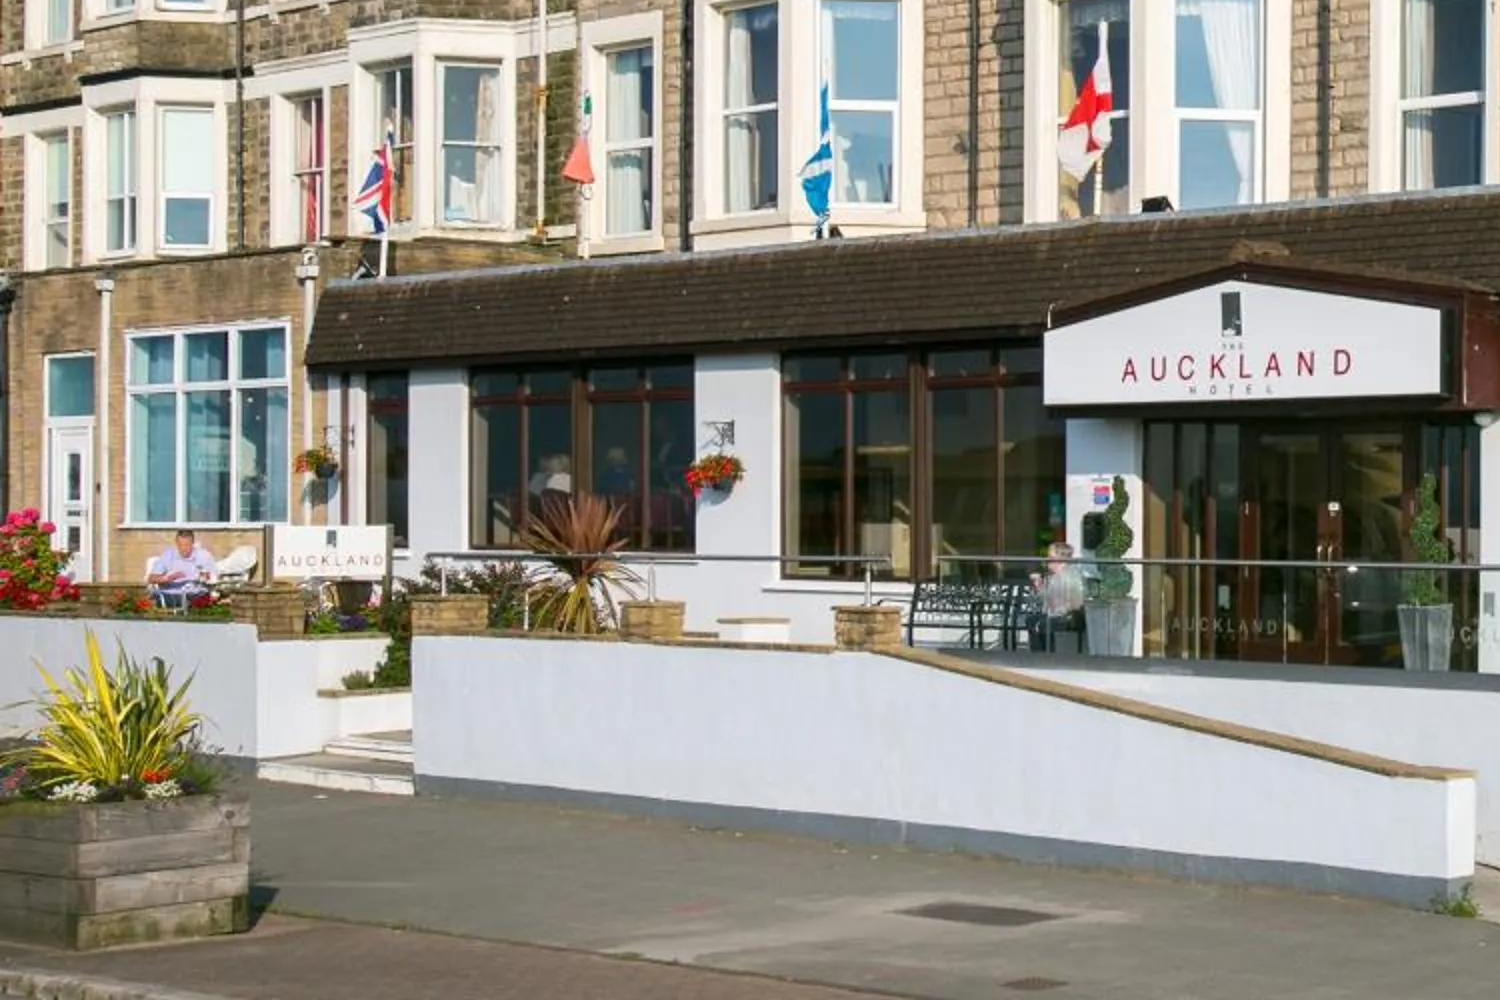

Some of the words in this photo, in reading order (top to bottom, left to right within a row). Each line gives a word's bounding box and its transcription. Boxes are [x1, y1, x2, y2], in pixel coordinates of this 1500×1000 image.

[1121, 349, 1351, 383] AUCKLAND
[1189, 384, 1274, 396] HOTEL
[278, 555, 383, 567] AUCKLAND
[1171, 616, 1279, 637] AUCKLAND
